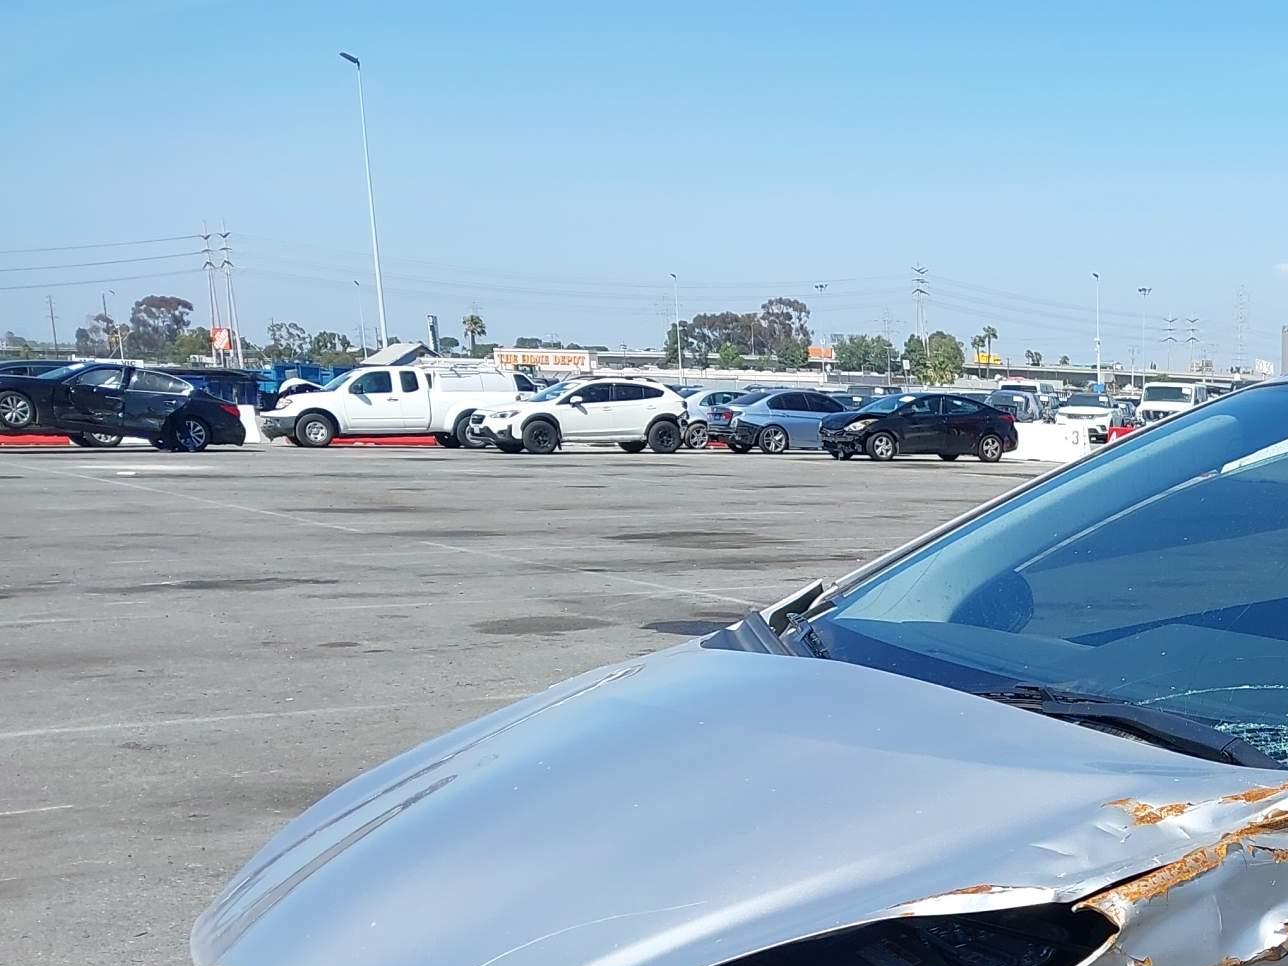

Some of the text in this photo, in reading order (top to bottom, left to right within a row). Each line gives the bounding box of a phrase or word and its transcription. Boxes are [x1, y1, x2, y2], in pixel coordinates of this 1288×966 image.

[497, 354, 518, 364] THE
[554, 354, 586, 366] DEPOT
[1072, 430, 1079, 445] 3
